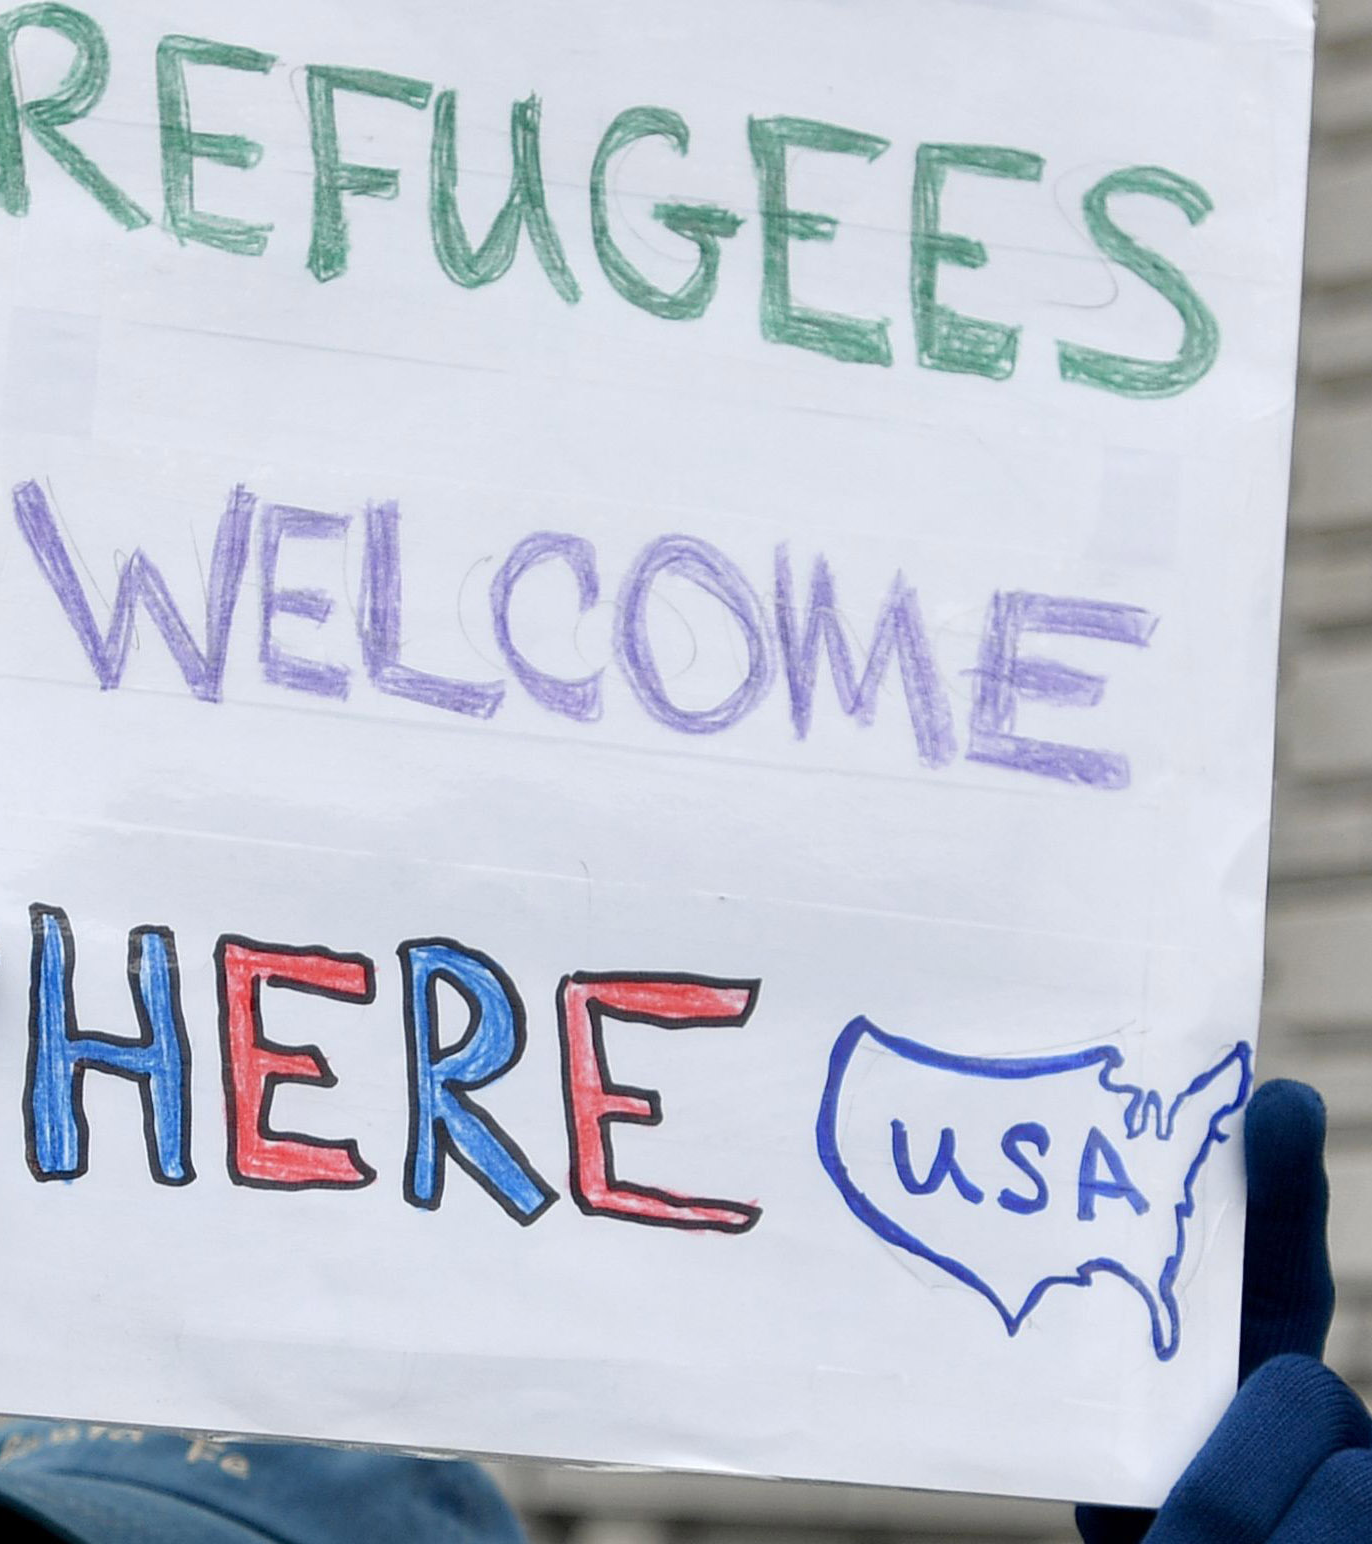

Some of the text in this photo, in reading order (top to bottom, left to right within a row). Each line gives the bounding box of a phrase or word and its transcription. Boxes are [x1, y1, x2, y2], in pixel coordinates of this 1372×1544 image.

[12, 480, 1160, 790] WELCOME
[22, 903, 1150, 1234] HERE USA
[187, 1438, 251, 1480] Fe
